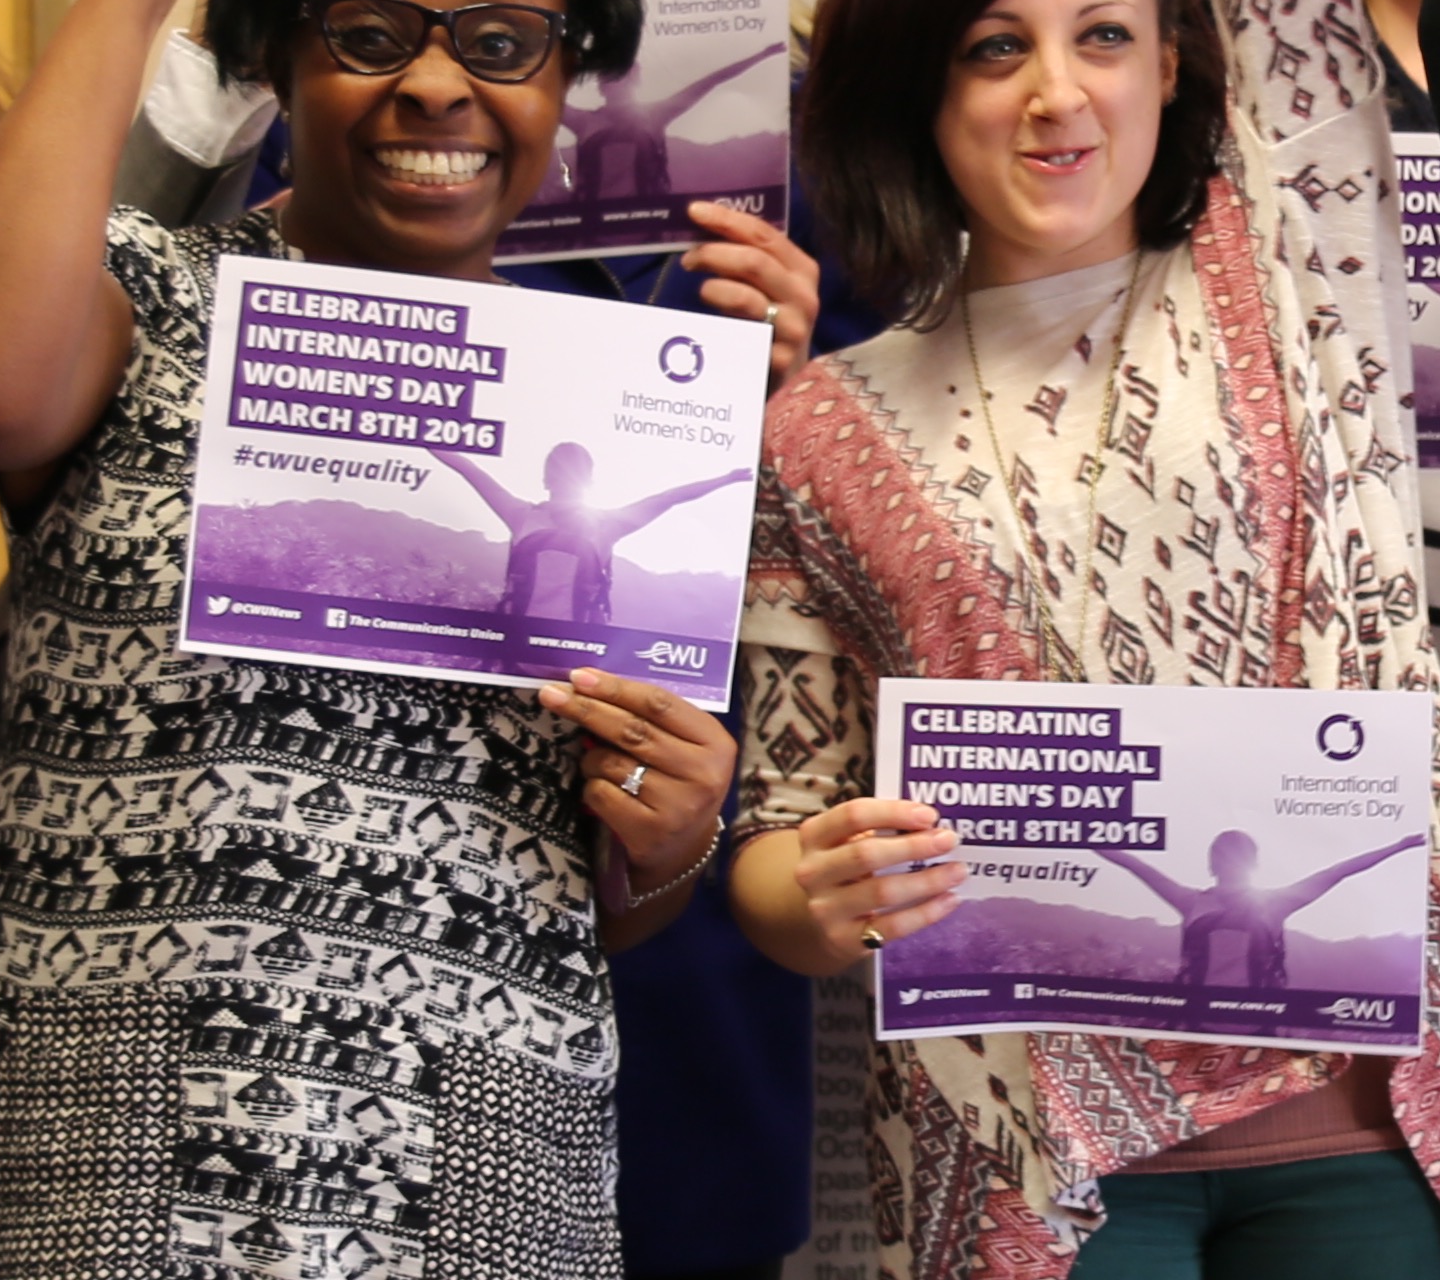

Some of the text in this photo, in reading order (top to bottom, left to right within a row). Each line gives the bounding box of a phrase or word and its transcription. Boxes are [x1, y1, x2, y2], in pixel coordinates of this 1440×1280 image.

[734, 12, 765, 32] Day
[250, 289, 458, 334] CELEBRATING
[246, 325, 497, 376] INTERNATIONAL
[400, 379, 466, 408] DAY
[621, 391, 733, 422] International
[238, 398, 496, 449] MARCH 8TH 2016
[700, 424, 735, 451] Day
[234, 444, 430, 490] #cwuequality
[651, 641, 706, 669] CWU
[911, 709, 1111, 736] CELEBRATING
[910, 746, 1155, 774] INTERNATIONAL
[1062, 785, 1125, 810] DAY
[1281, 774, 1398, 794] International
[1365, 799, 1404, 822] Day
[1024, 820, 1158, 845] 8TH 2016
